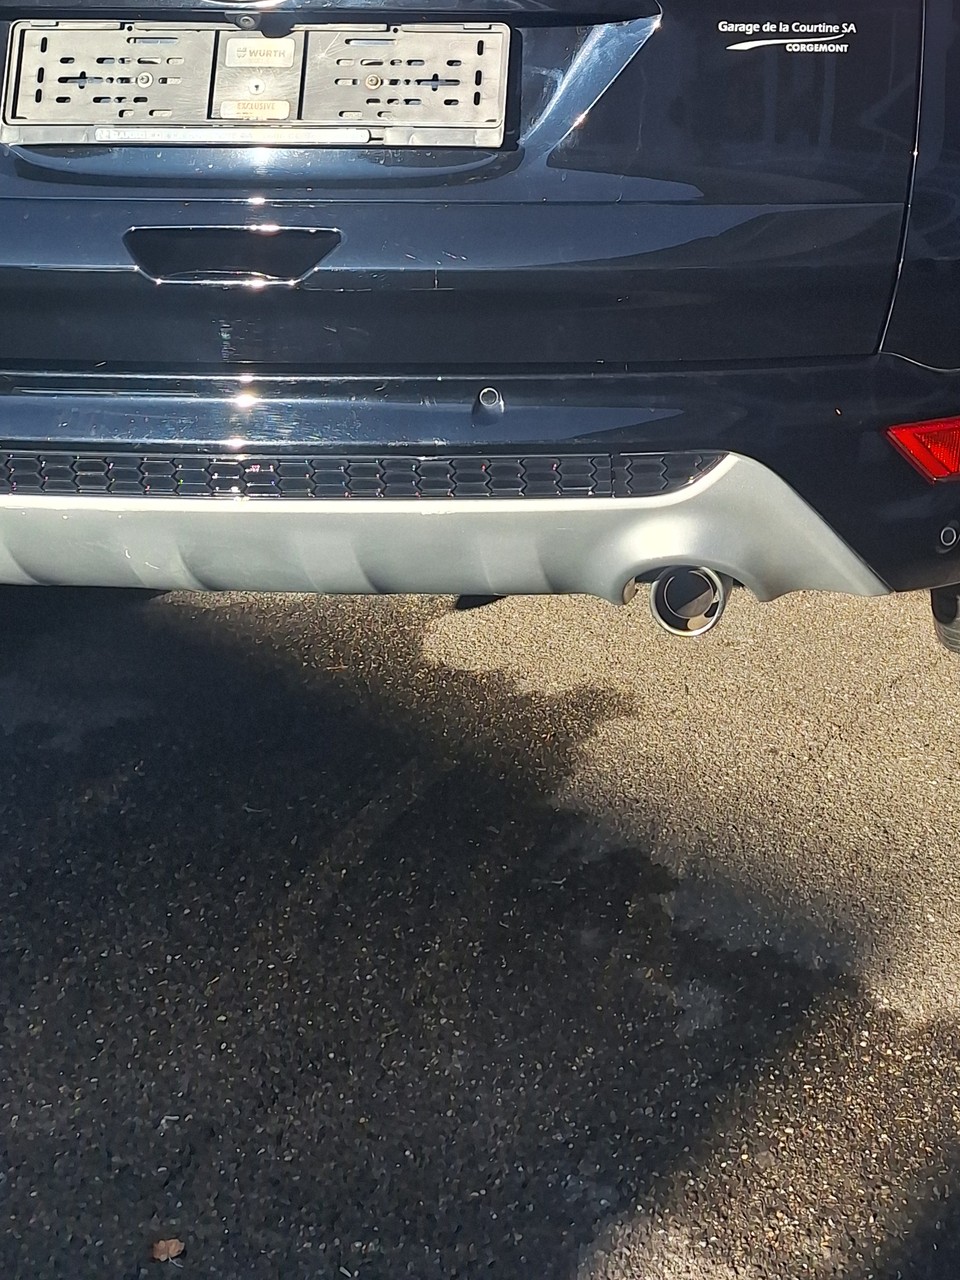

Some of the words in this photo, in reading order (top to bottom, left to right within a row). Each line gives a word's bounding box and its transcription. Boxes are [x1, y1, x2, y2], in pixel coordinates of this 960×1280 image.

[718, 21, 760, 34] Garage
[762, 22, 777, 33] de
[779, 22, 789, 33] la
[791, 22, 839, 33] Courtine
[841, 23, 857, 34] SA
[785, 43, 849, 53] CORGEMONT
